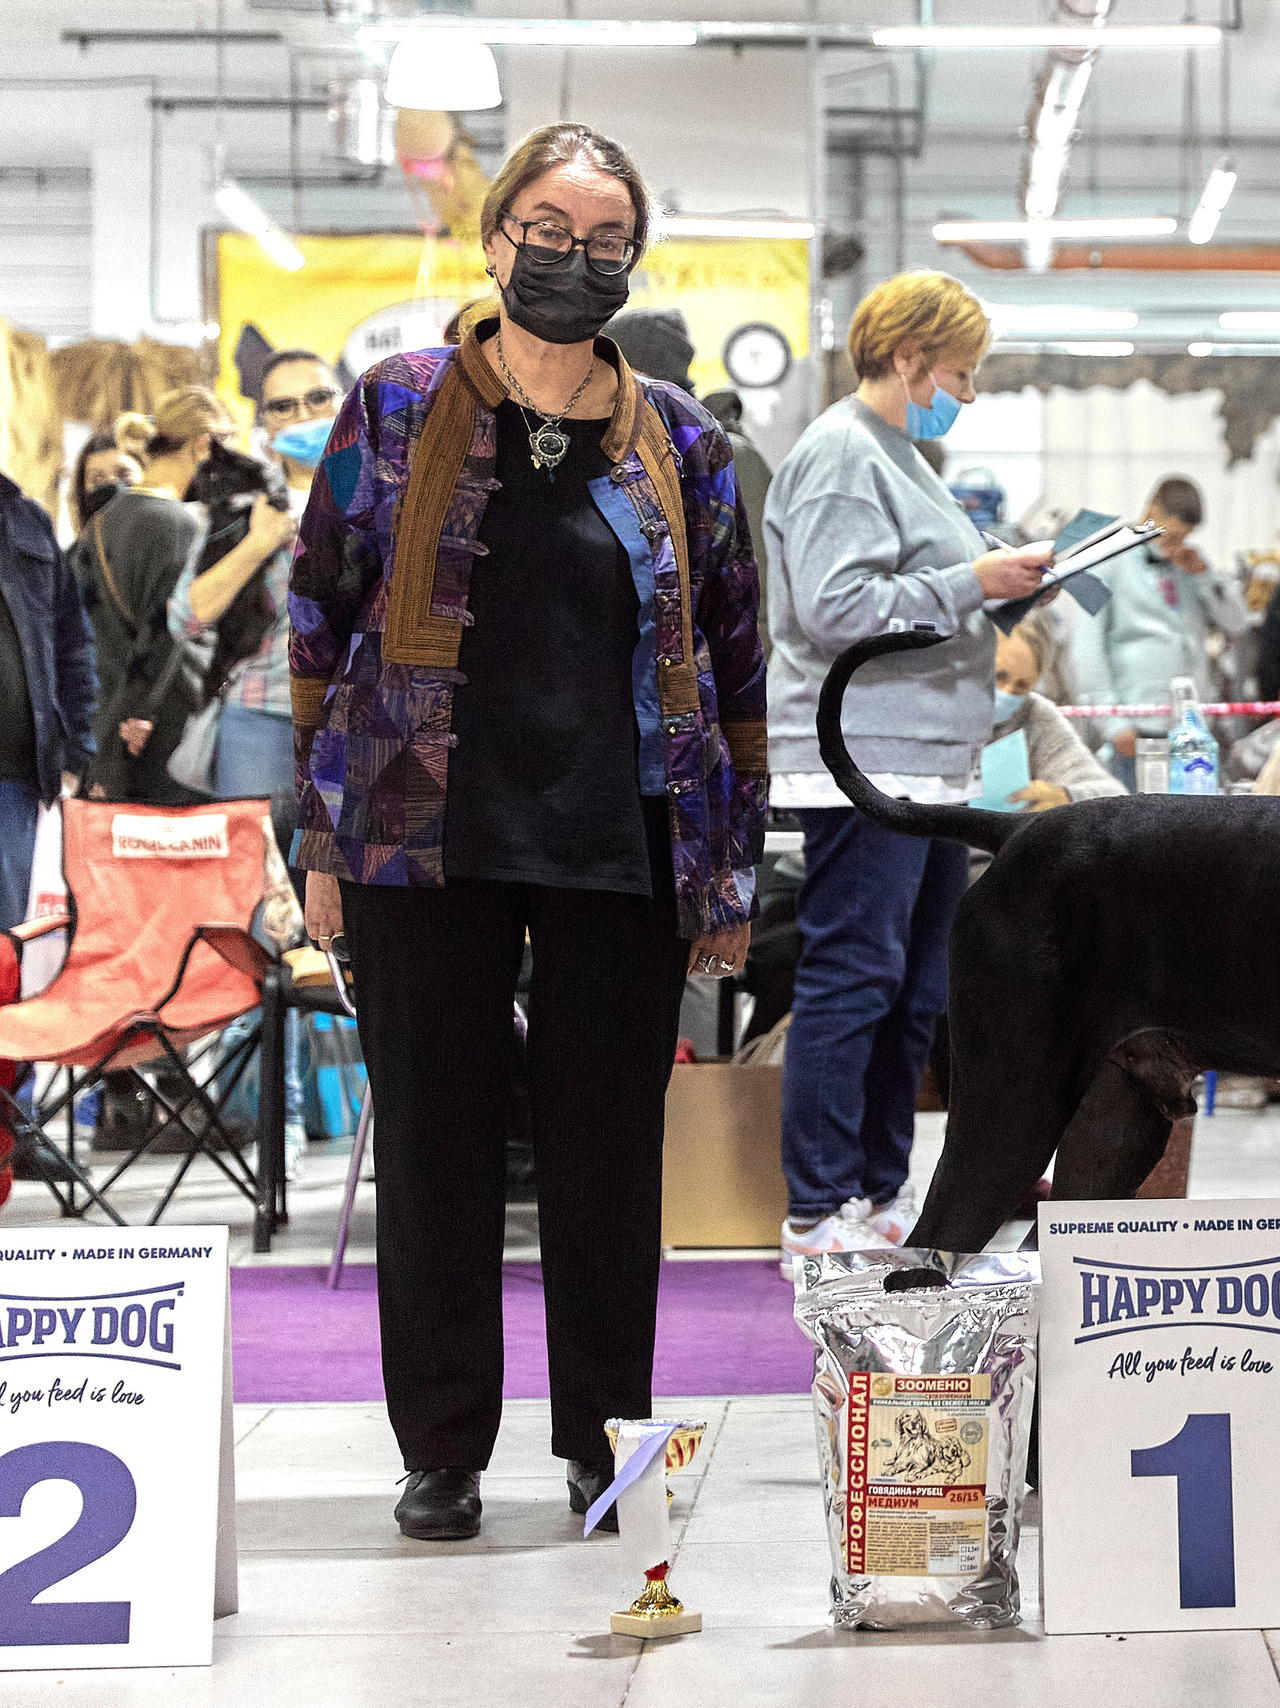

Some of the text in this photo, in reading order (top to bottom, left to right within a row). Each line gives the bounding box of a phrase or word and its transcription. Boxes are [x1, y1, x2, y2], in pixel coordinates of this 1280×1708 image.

[1050, 1221, 1114, 1234] SUPREME
[1117, 1220, 1178, 1233] QUALITY
[1194, 1219, 1235, 1232] MADE
[1238, 1219, 1253, 1231] IN
[0, 1247, 213, 1261] UALITY MADE IN GERMANY
[1080, 1271, 1211, 1329] HAPPY
[0, 1299, 176, 1354] PPY DOG
[1108, 1347, 1274, 1383] All you feed is love
[10, 1389, 45, 1414] you
[48, 1378, 88, 1407] feed
[91, 1386, 107, 1403] is
[112, 1380, 146, 1405] love
[897, 1380, 969, 1391] ЗООМЕНЮ
[850, 1375, 868, 1571] ПРОФЕССИОНАЛ
[869, 1486, 944, 1497] ГОВЯДИНА+РУБЕЦ
[869, 1498, 919, 1509] МЕДИУМ
[950, 1492, 979, 1503] 26/15
[1131, 1413, 1236, 1610] 1
[0, 1441, 137, 1647] 2
